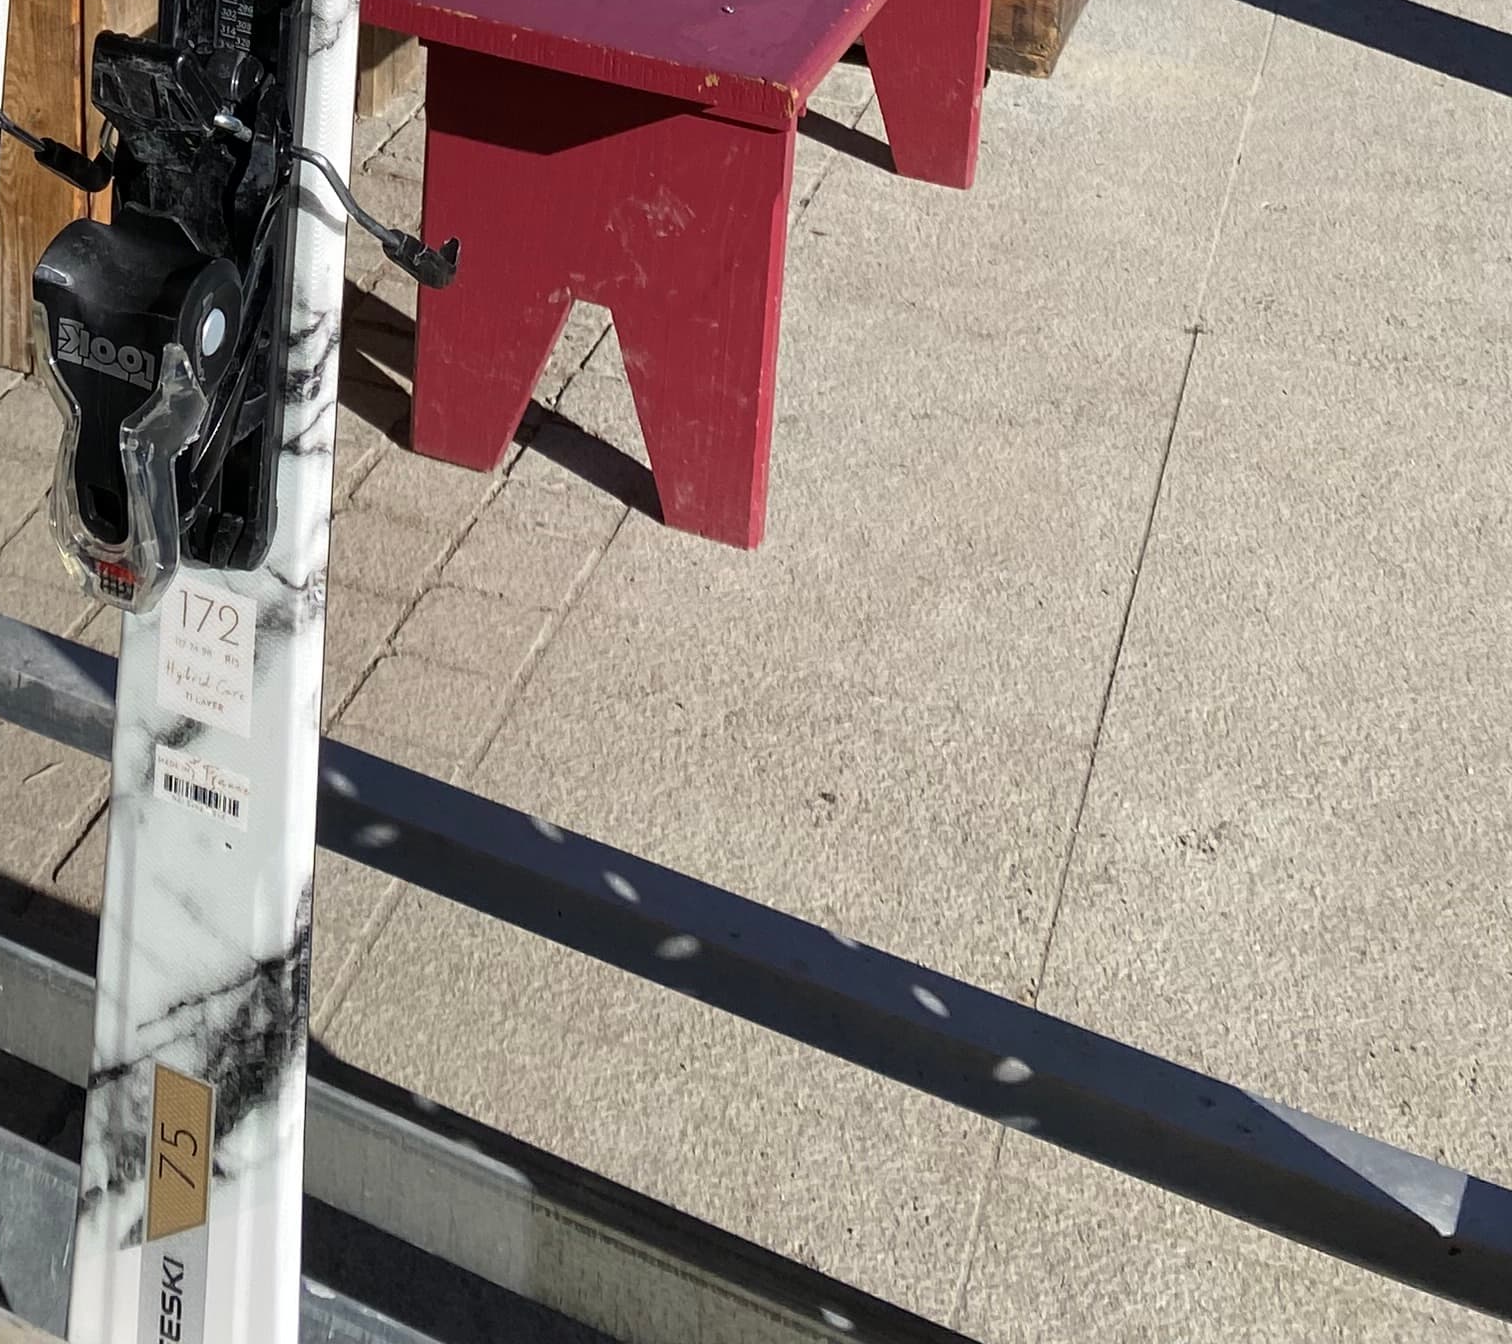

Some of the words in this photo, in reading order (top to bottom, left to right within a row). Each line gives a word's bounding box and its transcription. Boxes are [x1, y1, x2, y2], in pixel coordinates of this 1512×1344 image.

[57, 320, 156, 384] LOOK
[180, 589, 240, 647] 172
[166, 658, 211, 688] Hybrid
[157, 1120, 198, 1191] 75
